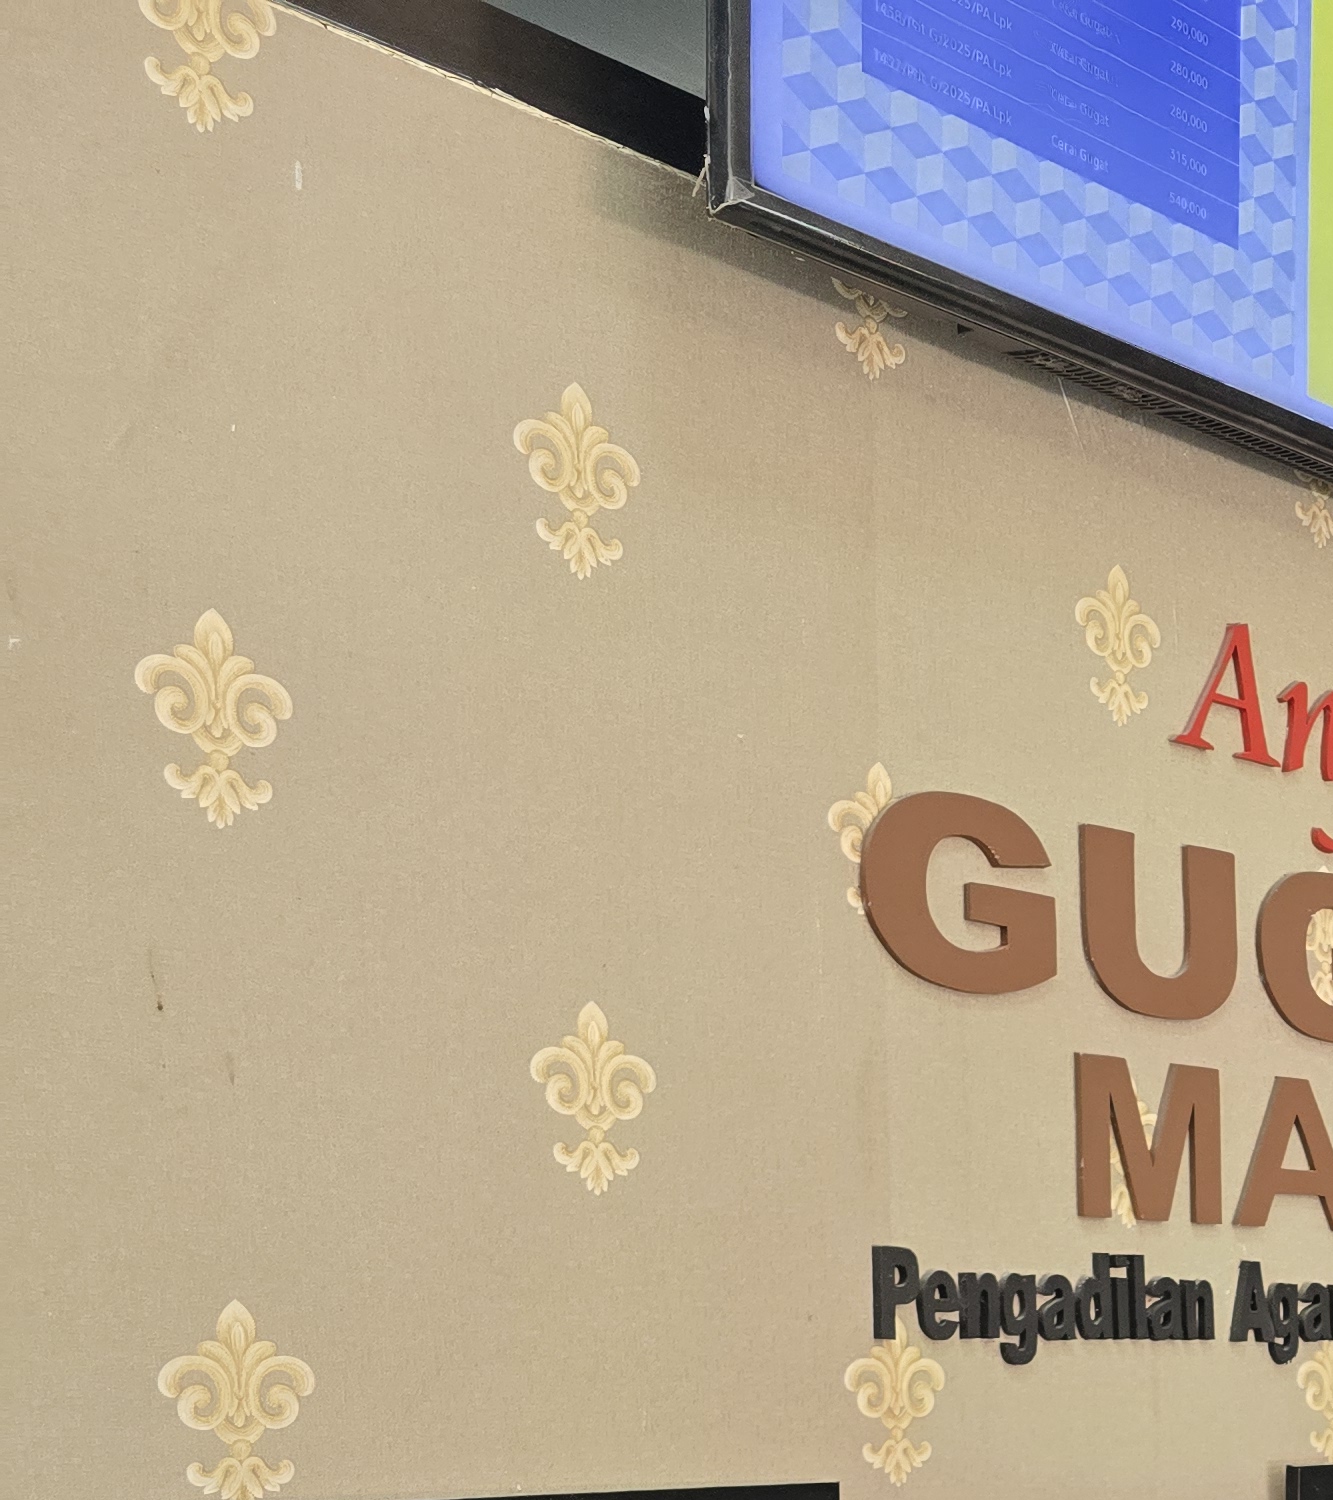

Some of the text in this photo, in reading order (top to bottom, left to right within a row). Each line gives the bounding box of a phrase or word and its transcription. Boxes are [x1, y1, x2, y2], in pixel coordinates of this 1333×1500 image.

[1170, 16, 1209, 46] 290,000
[1170, 60, 1208, 90] 280,000
[1170, 104, 1208, 133] 280,000
[1051, 134, 1109, 174] Cerai Gugat
[1169, 148, 1208, 177] 315,000
[1169, 191, 1207, 220] 540,000
[871, 1244, 1216, 1366] Pengadilan
